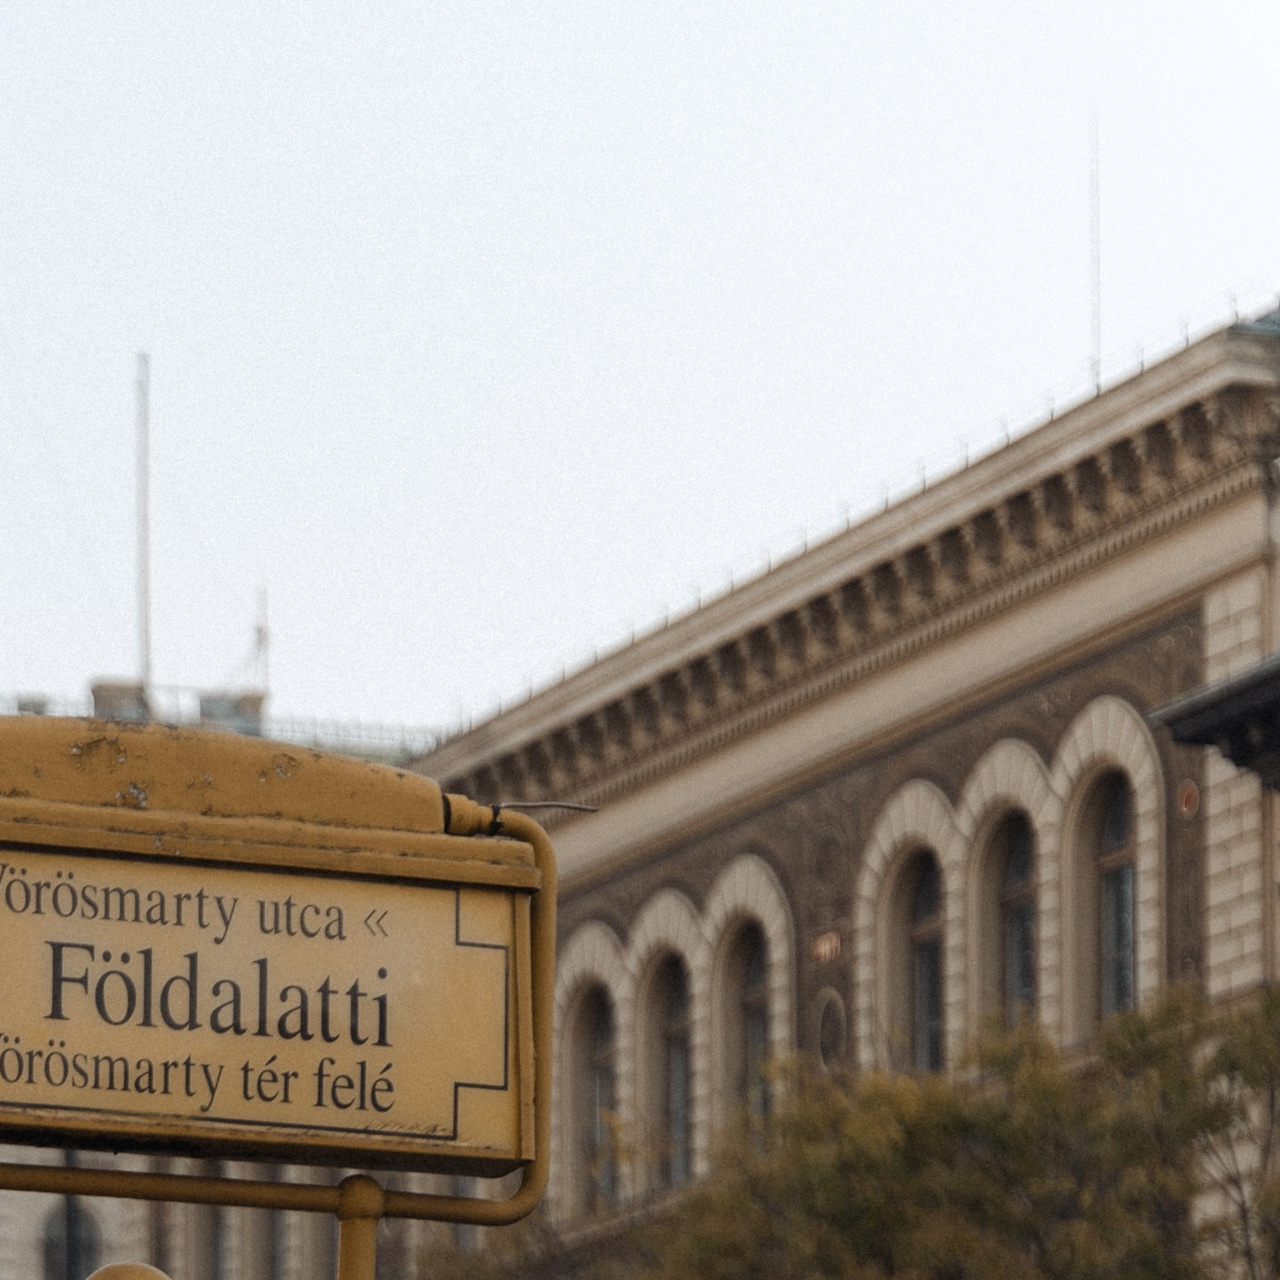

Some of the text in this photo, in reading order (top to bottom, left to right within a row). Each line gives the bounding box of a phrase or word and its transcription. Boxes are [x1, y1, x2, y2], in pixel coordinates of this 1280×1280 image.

[258, 899, 347, 941] utca
[43, 940, 393, 1048] Földalatti
[240, 1054, 300, 1104] tér
[313, 1057, 395, 1114] felé
